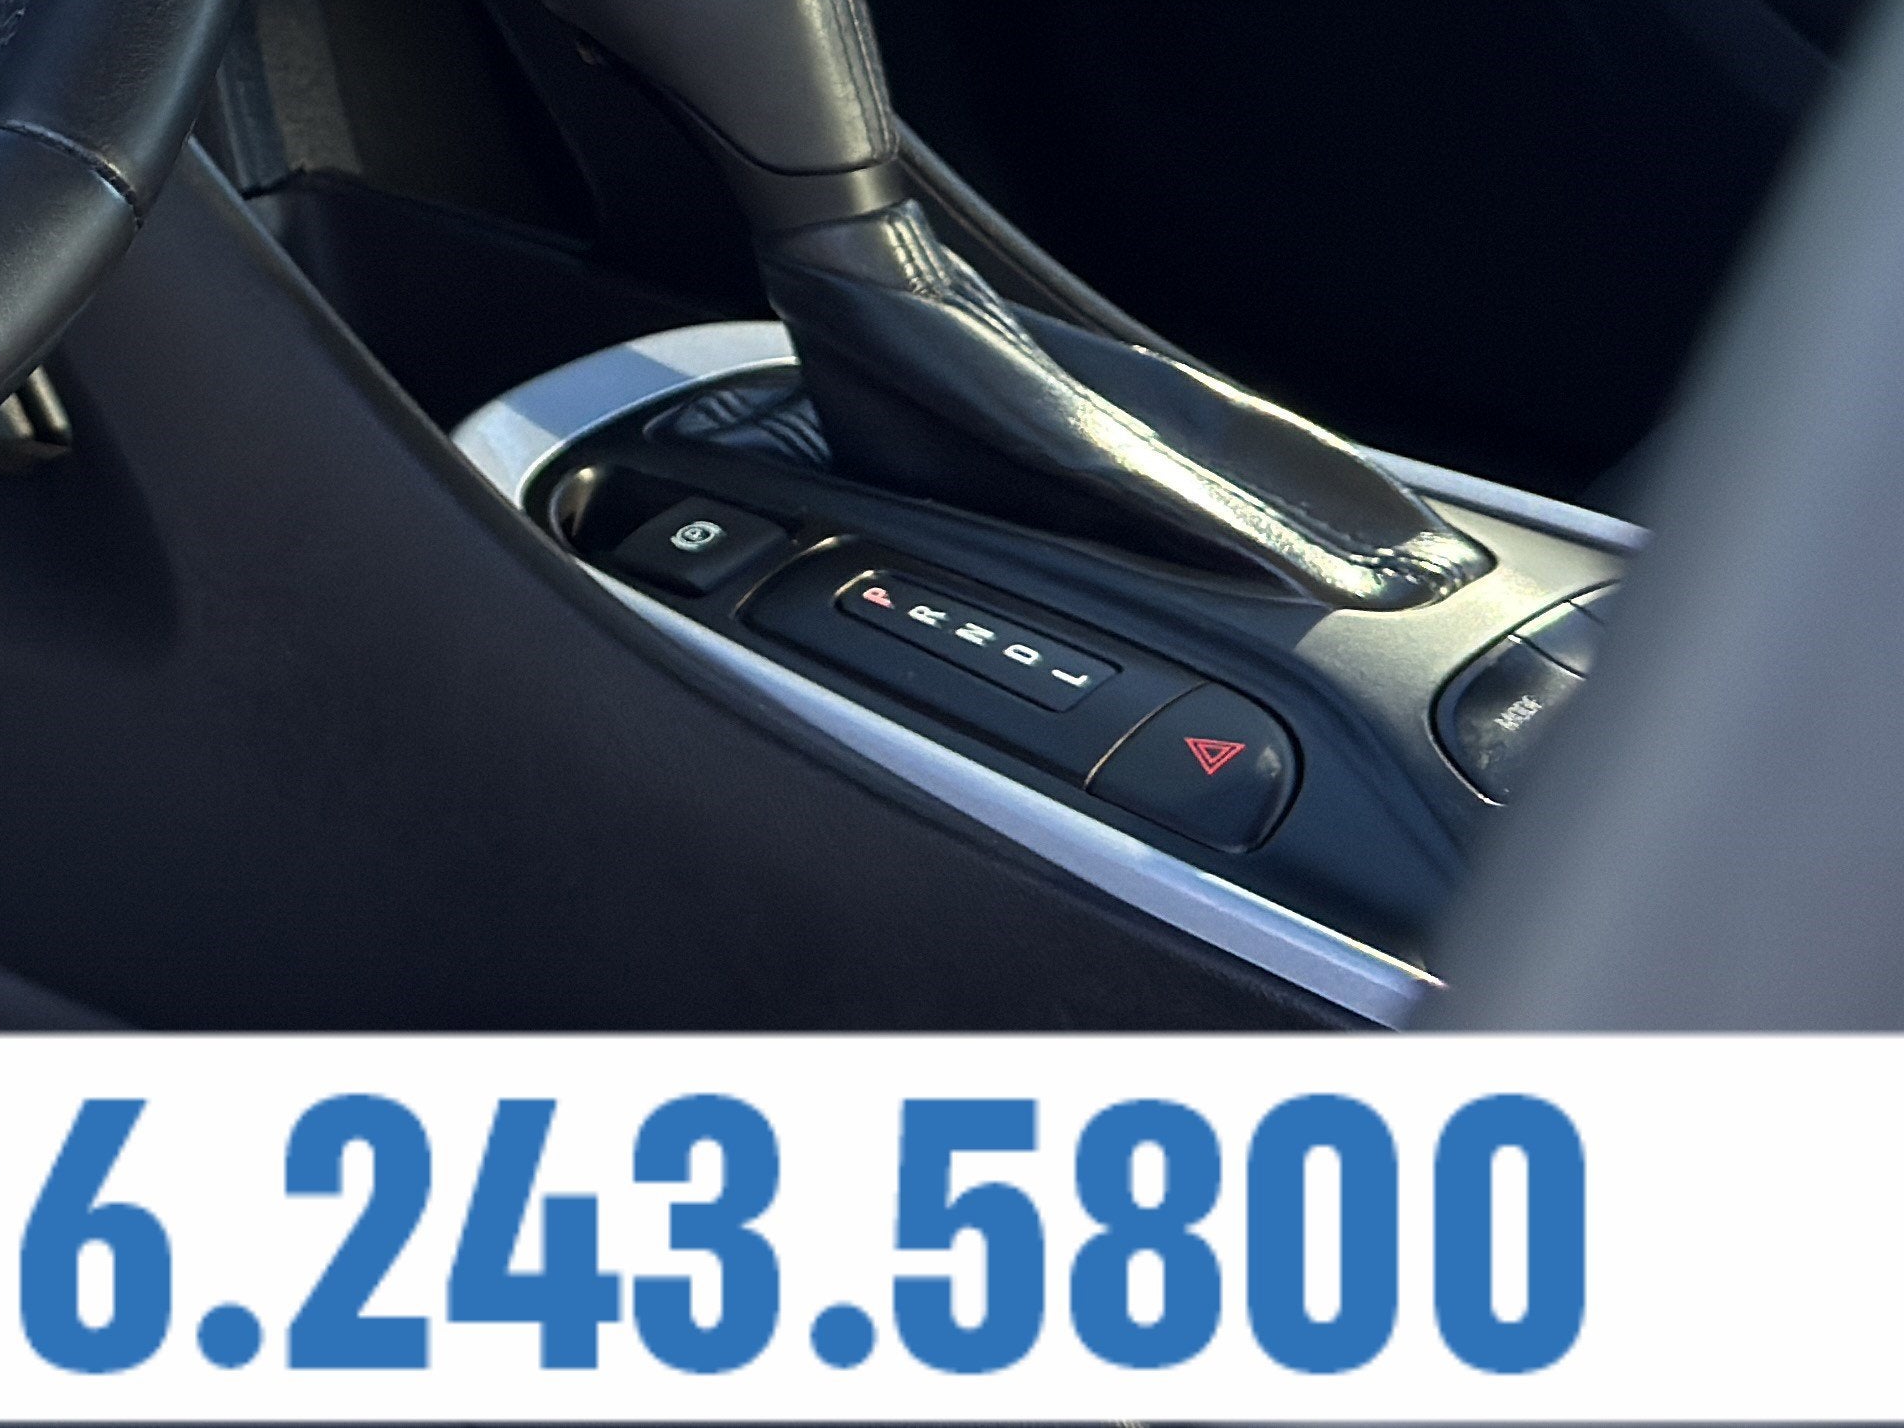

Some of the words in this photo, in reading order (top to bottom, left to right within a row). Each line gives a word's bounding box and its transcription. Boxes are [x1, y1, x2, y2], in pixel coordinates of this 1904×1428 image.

[862, 587, 894, 609] P
[907, 605, 948, 628] R
[955, 622, 996, 646] N
[1002, 644, 1042, 667] D
[1051, 669, 1090, 689] L
